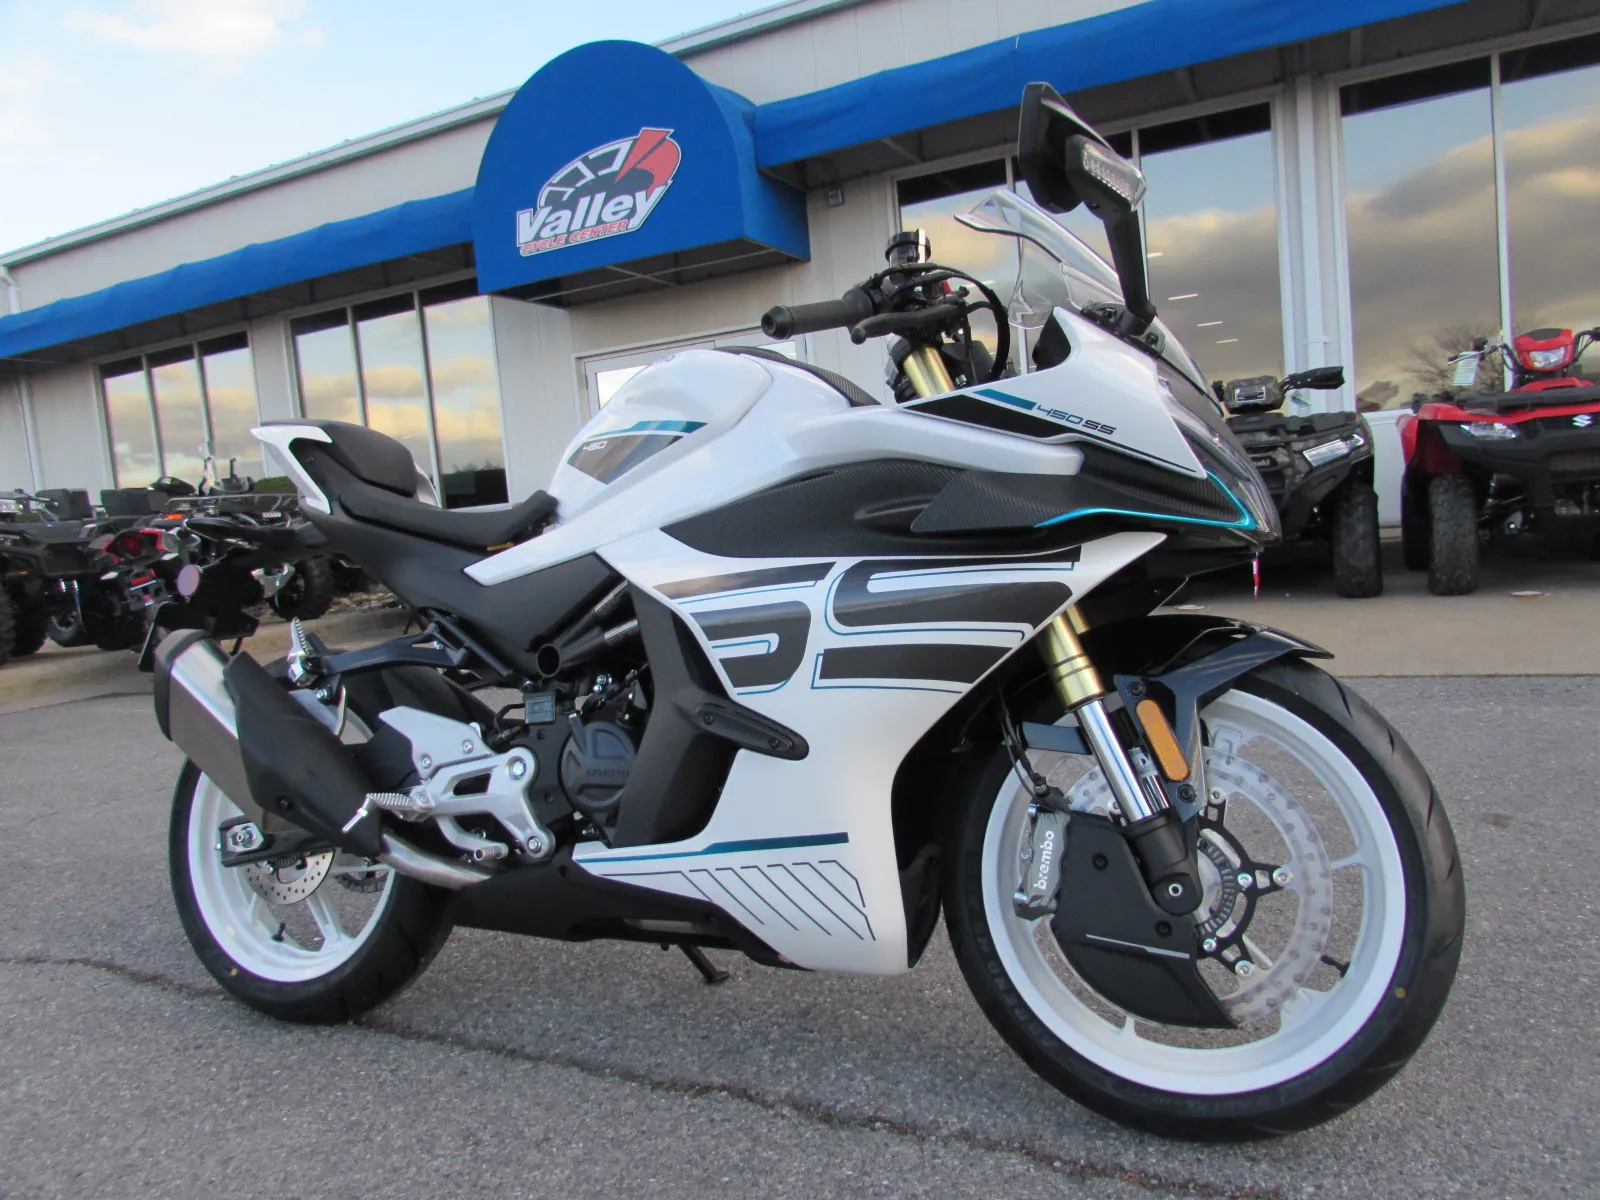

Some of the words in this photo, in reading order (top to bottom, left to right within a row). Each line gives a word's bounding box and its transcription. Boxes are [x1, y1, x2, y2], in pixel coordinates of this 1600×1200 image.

[518, 185, 667, 244] Valley
[521, 233, 566, 255] CYCLE
[569, 220, 629, 244] CENTER
[584, 441, 607, 452] 450
[1033, 830, 1055, 890] brembo
